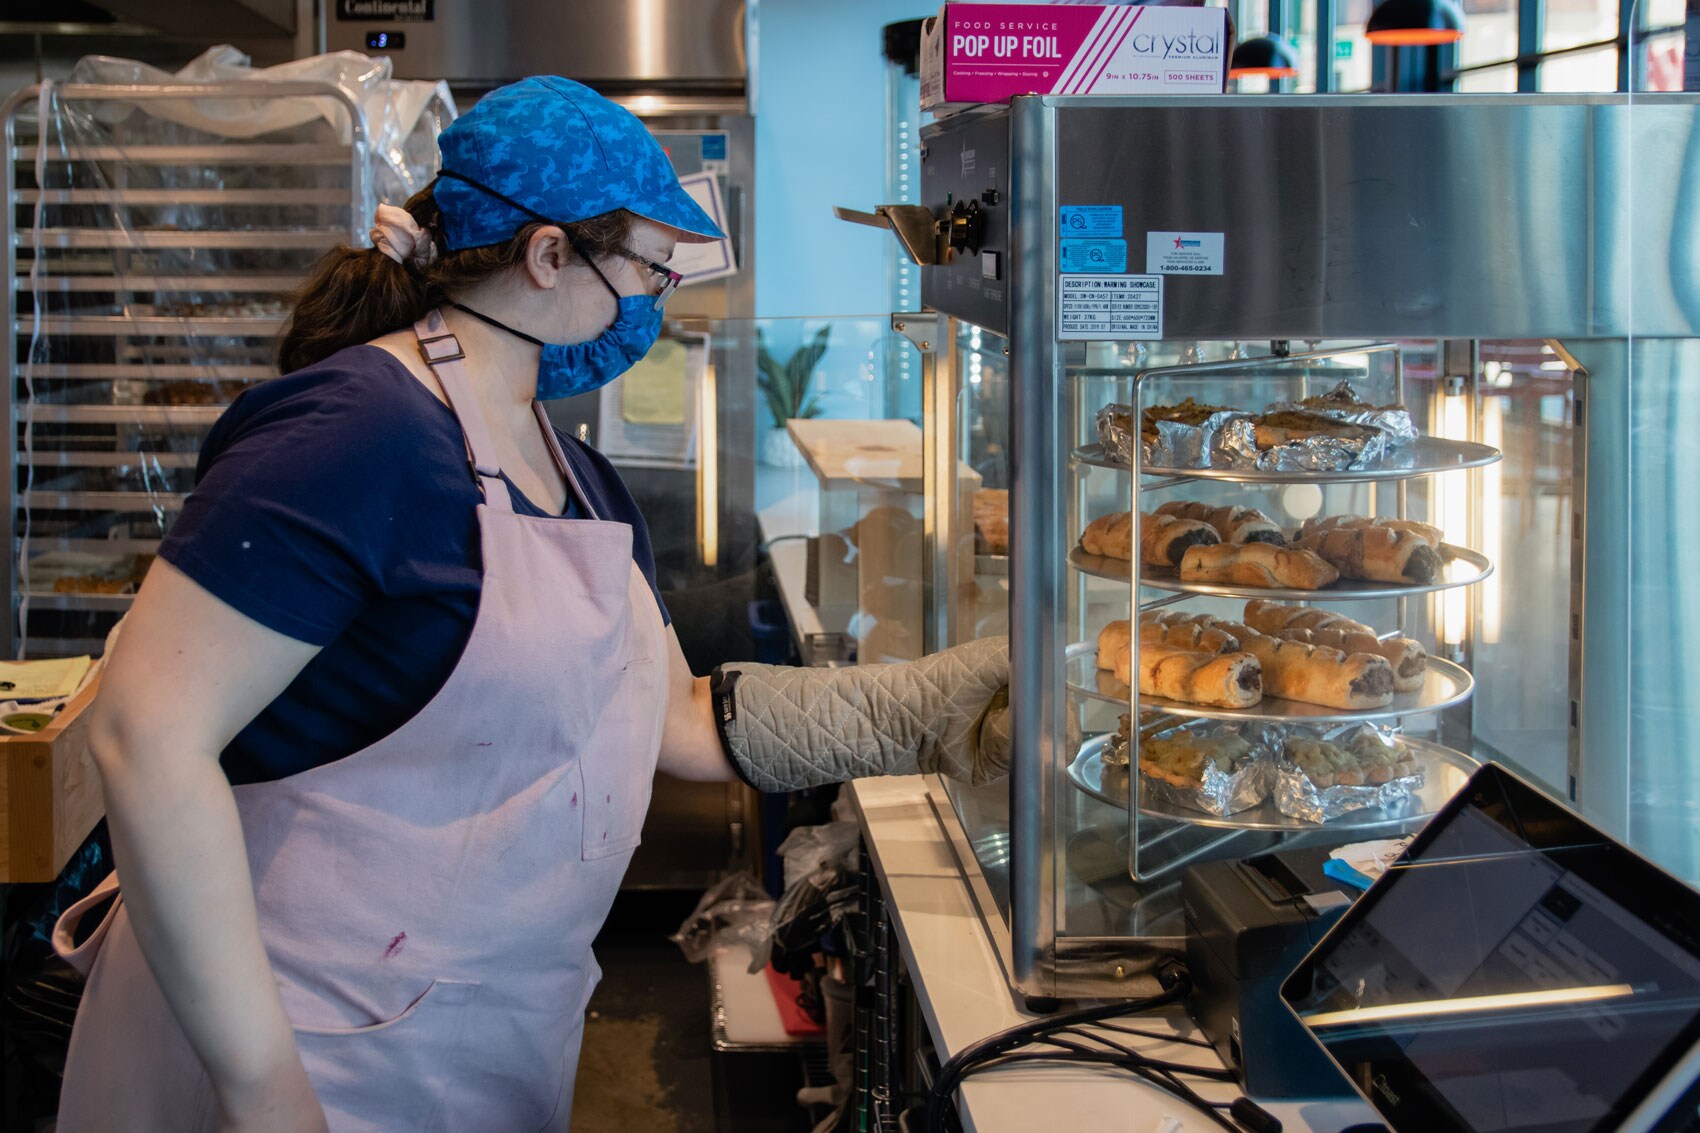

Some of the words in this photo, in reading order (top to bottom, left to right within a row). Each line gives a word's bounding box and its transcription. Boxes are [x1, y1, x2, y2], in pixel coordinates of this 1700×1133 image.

[954, 21, 991, 29] FOOD
[999, 22, 1058, 31] SERVICE
[953, 35, 990, 57] POP
[994, 35, 1018, 58] UP
[1023, 36, 1062, 58] FOIL
[1133, 27, 1219, 60] crystal
